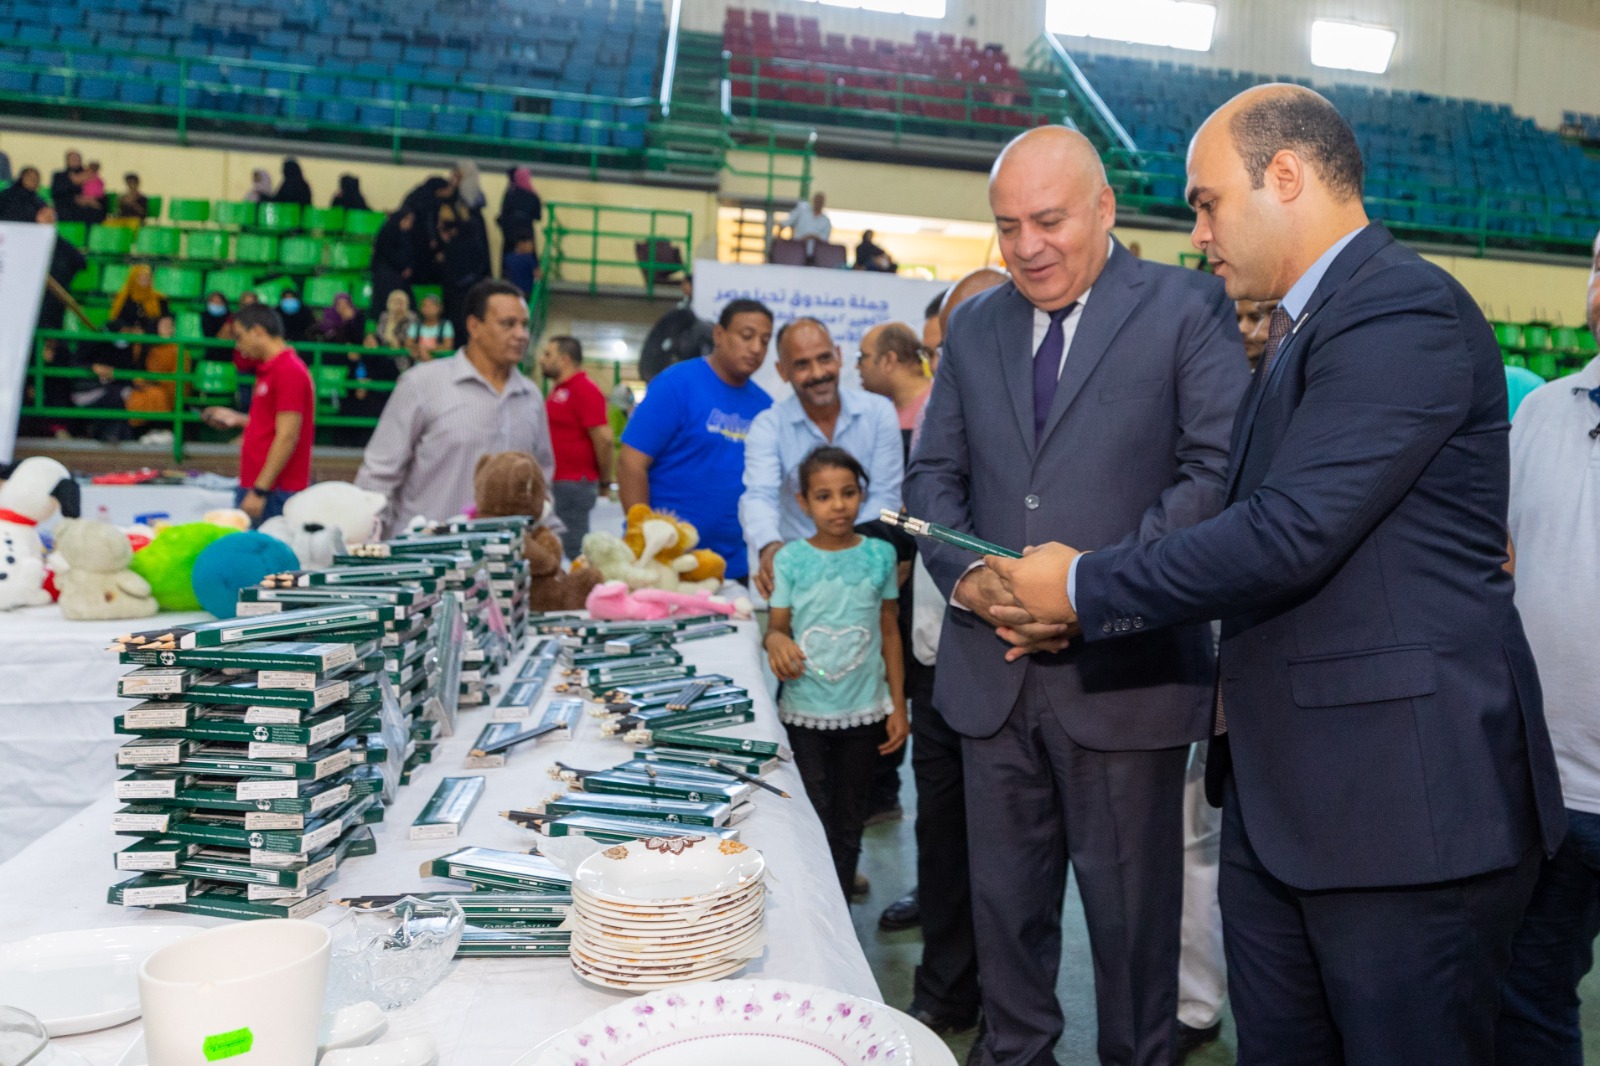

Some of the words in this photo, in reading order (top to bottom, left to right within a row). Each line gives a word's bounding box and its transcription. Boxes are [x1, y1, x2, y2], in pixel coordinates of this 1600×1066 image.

[790, 289, 845, 308] صندوق
[849, 293, 889, 311] حملة
[482, 922, 551, 930] FABER-CASTELL
